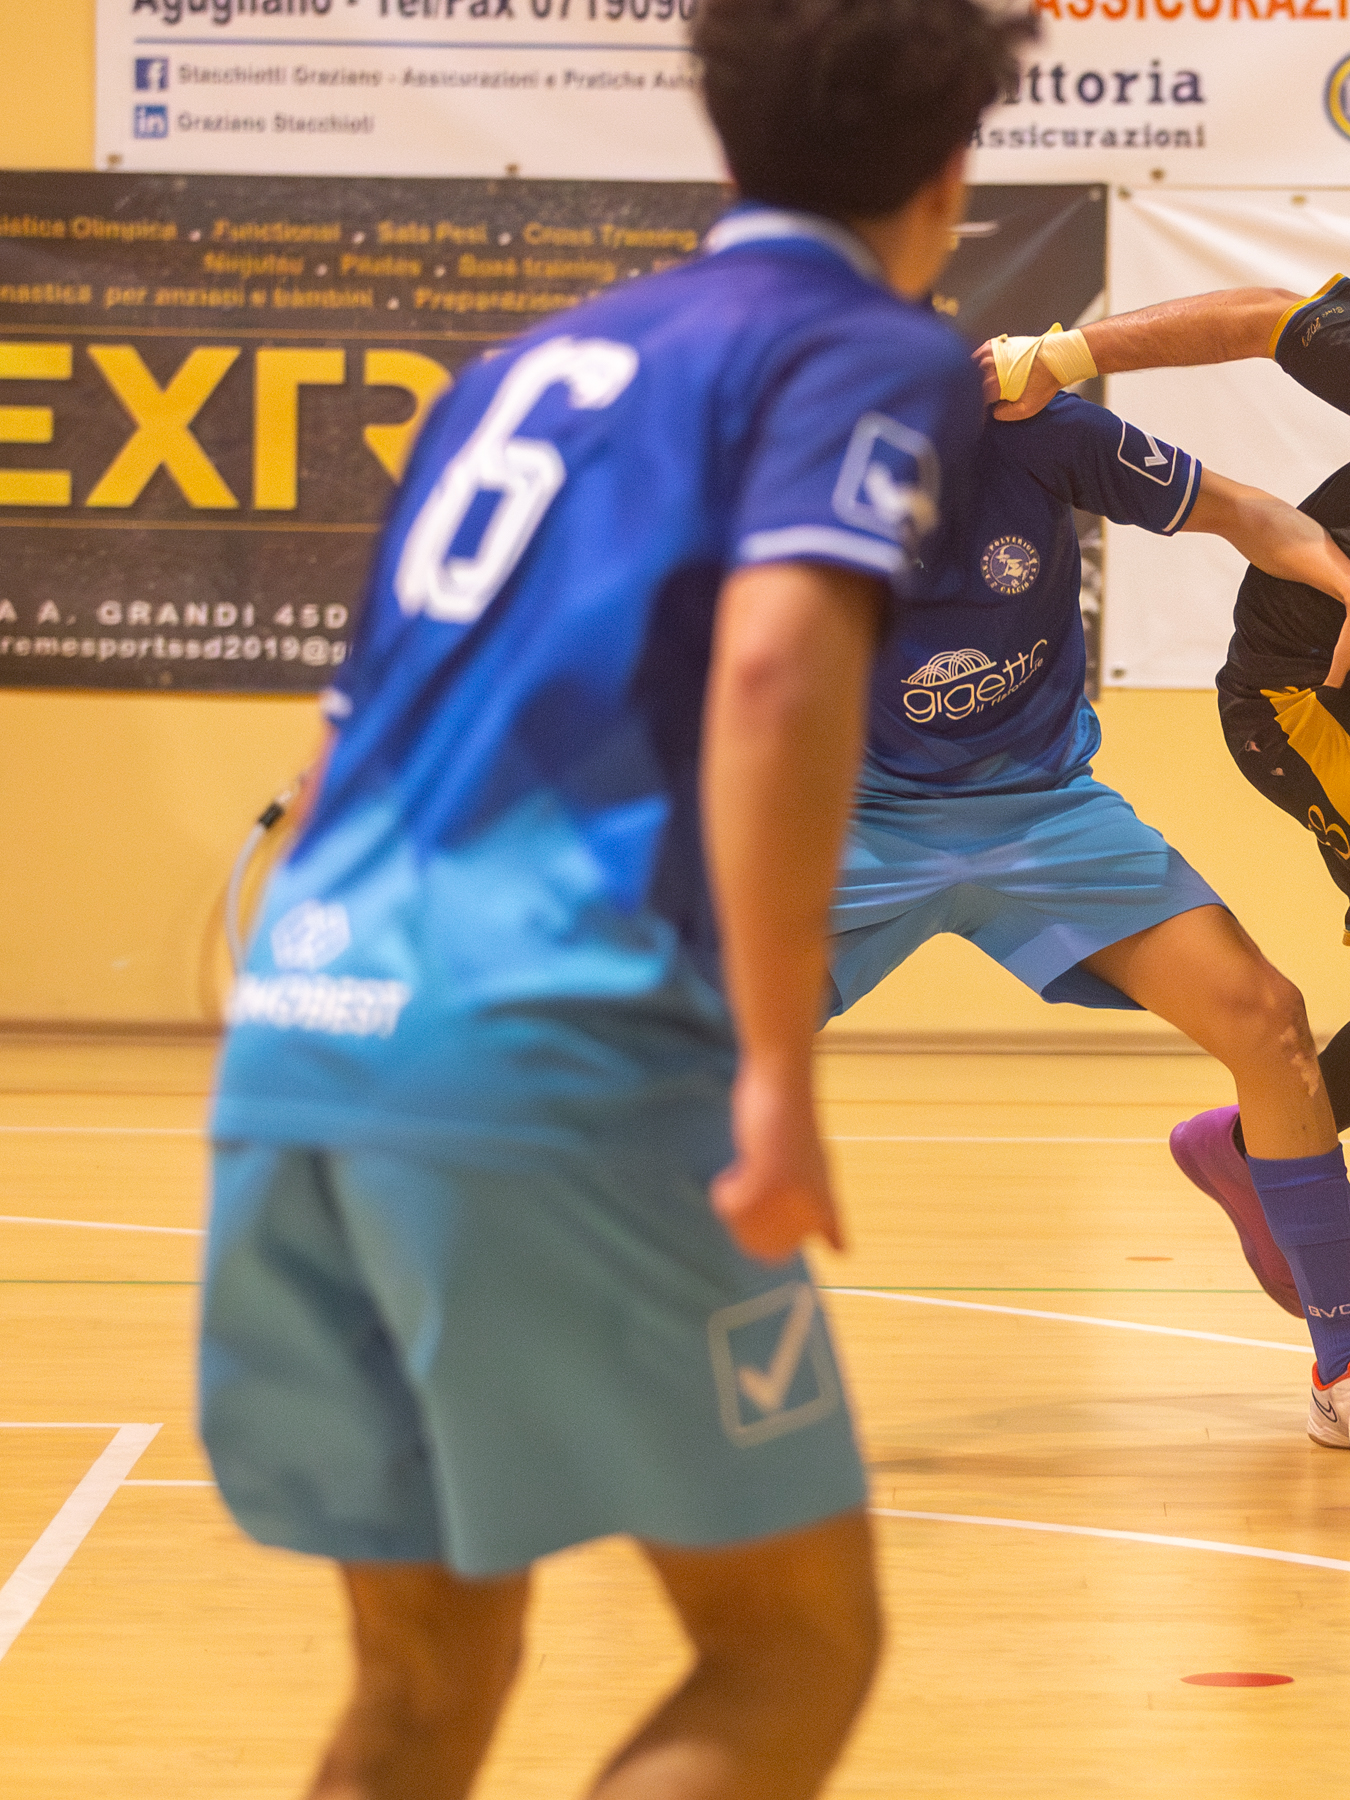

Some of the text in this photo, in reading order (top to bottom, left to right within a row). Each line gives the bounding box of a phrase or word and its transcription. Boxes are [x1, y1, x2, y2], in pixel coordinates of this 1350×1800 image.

[292, 67, 382, 87] Graziano
[1002, 58, 1206, 105] ttoria
[177, 112, 266, 133] Graziano
[393, 334, 640, 626] 6
[97, 599, 255, 628] GRANDI
